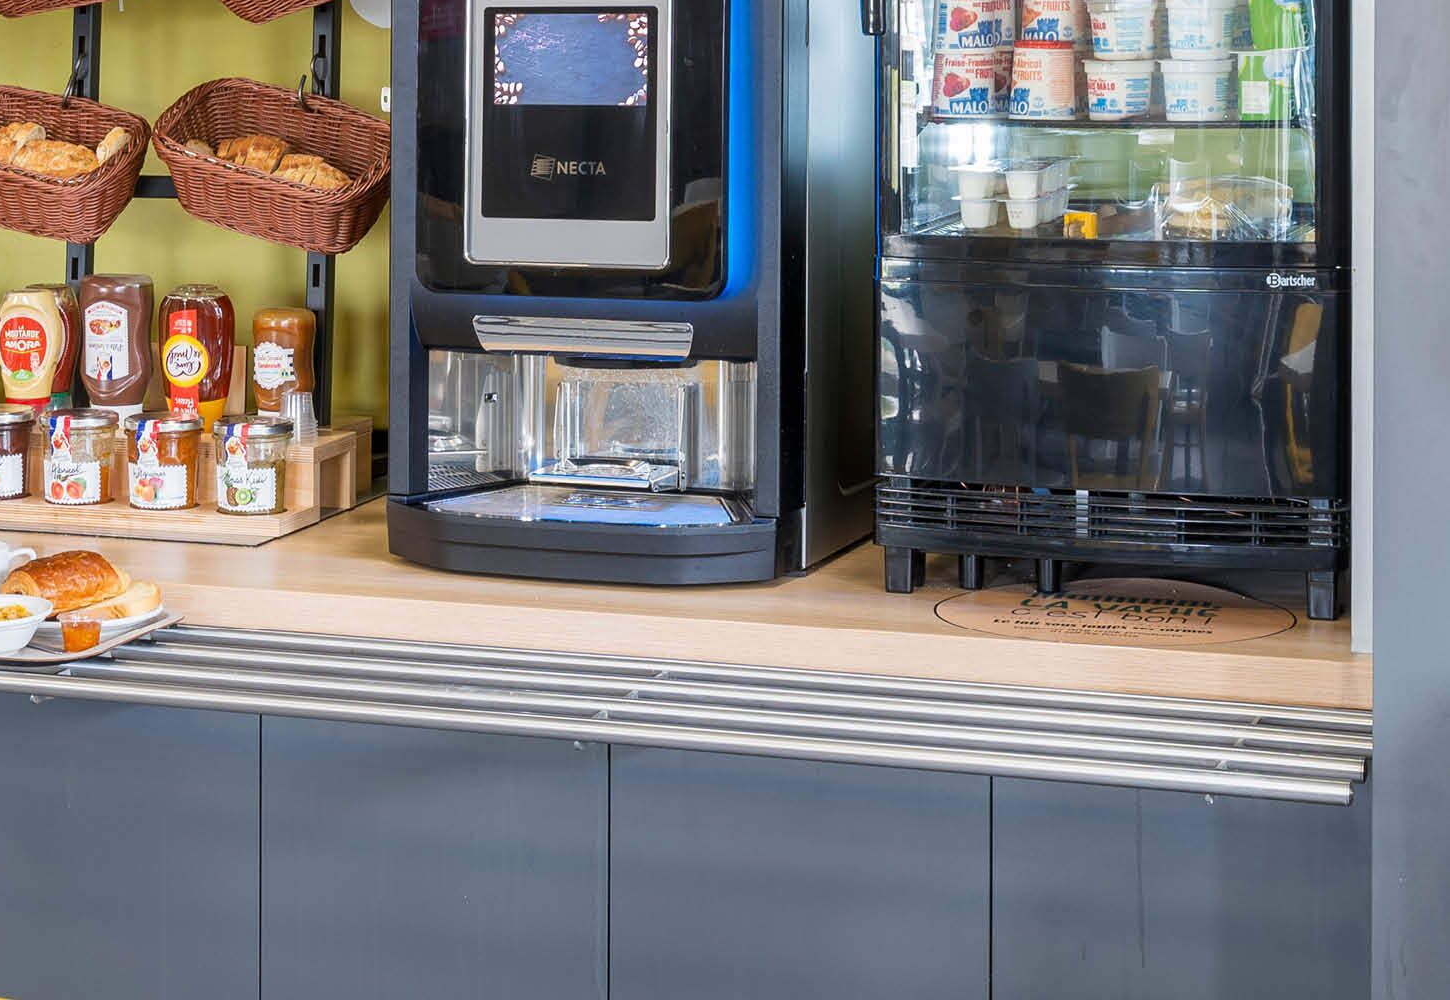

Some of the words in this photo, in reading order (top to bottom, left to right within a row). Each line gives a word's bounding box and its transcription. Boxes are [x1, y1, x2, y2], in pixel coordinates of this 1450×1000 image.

[951, 100, 988, 114] MALO
[557, 160, 606, 176] NECTA
[1266, 273, 1316, 288] Bartscher
[4, 339, 41, 351] AMORA
